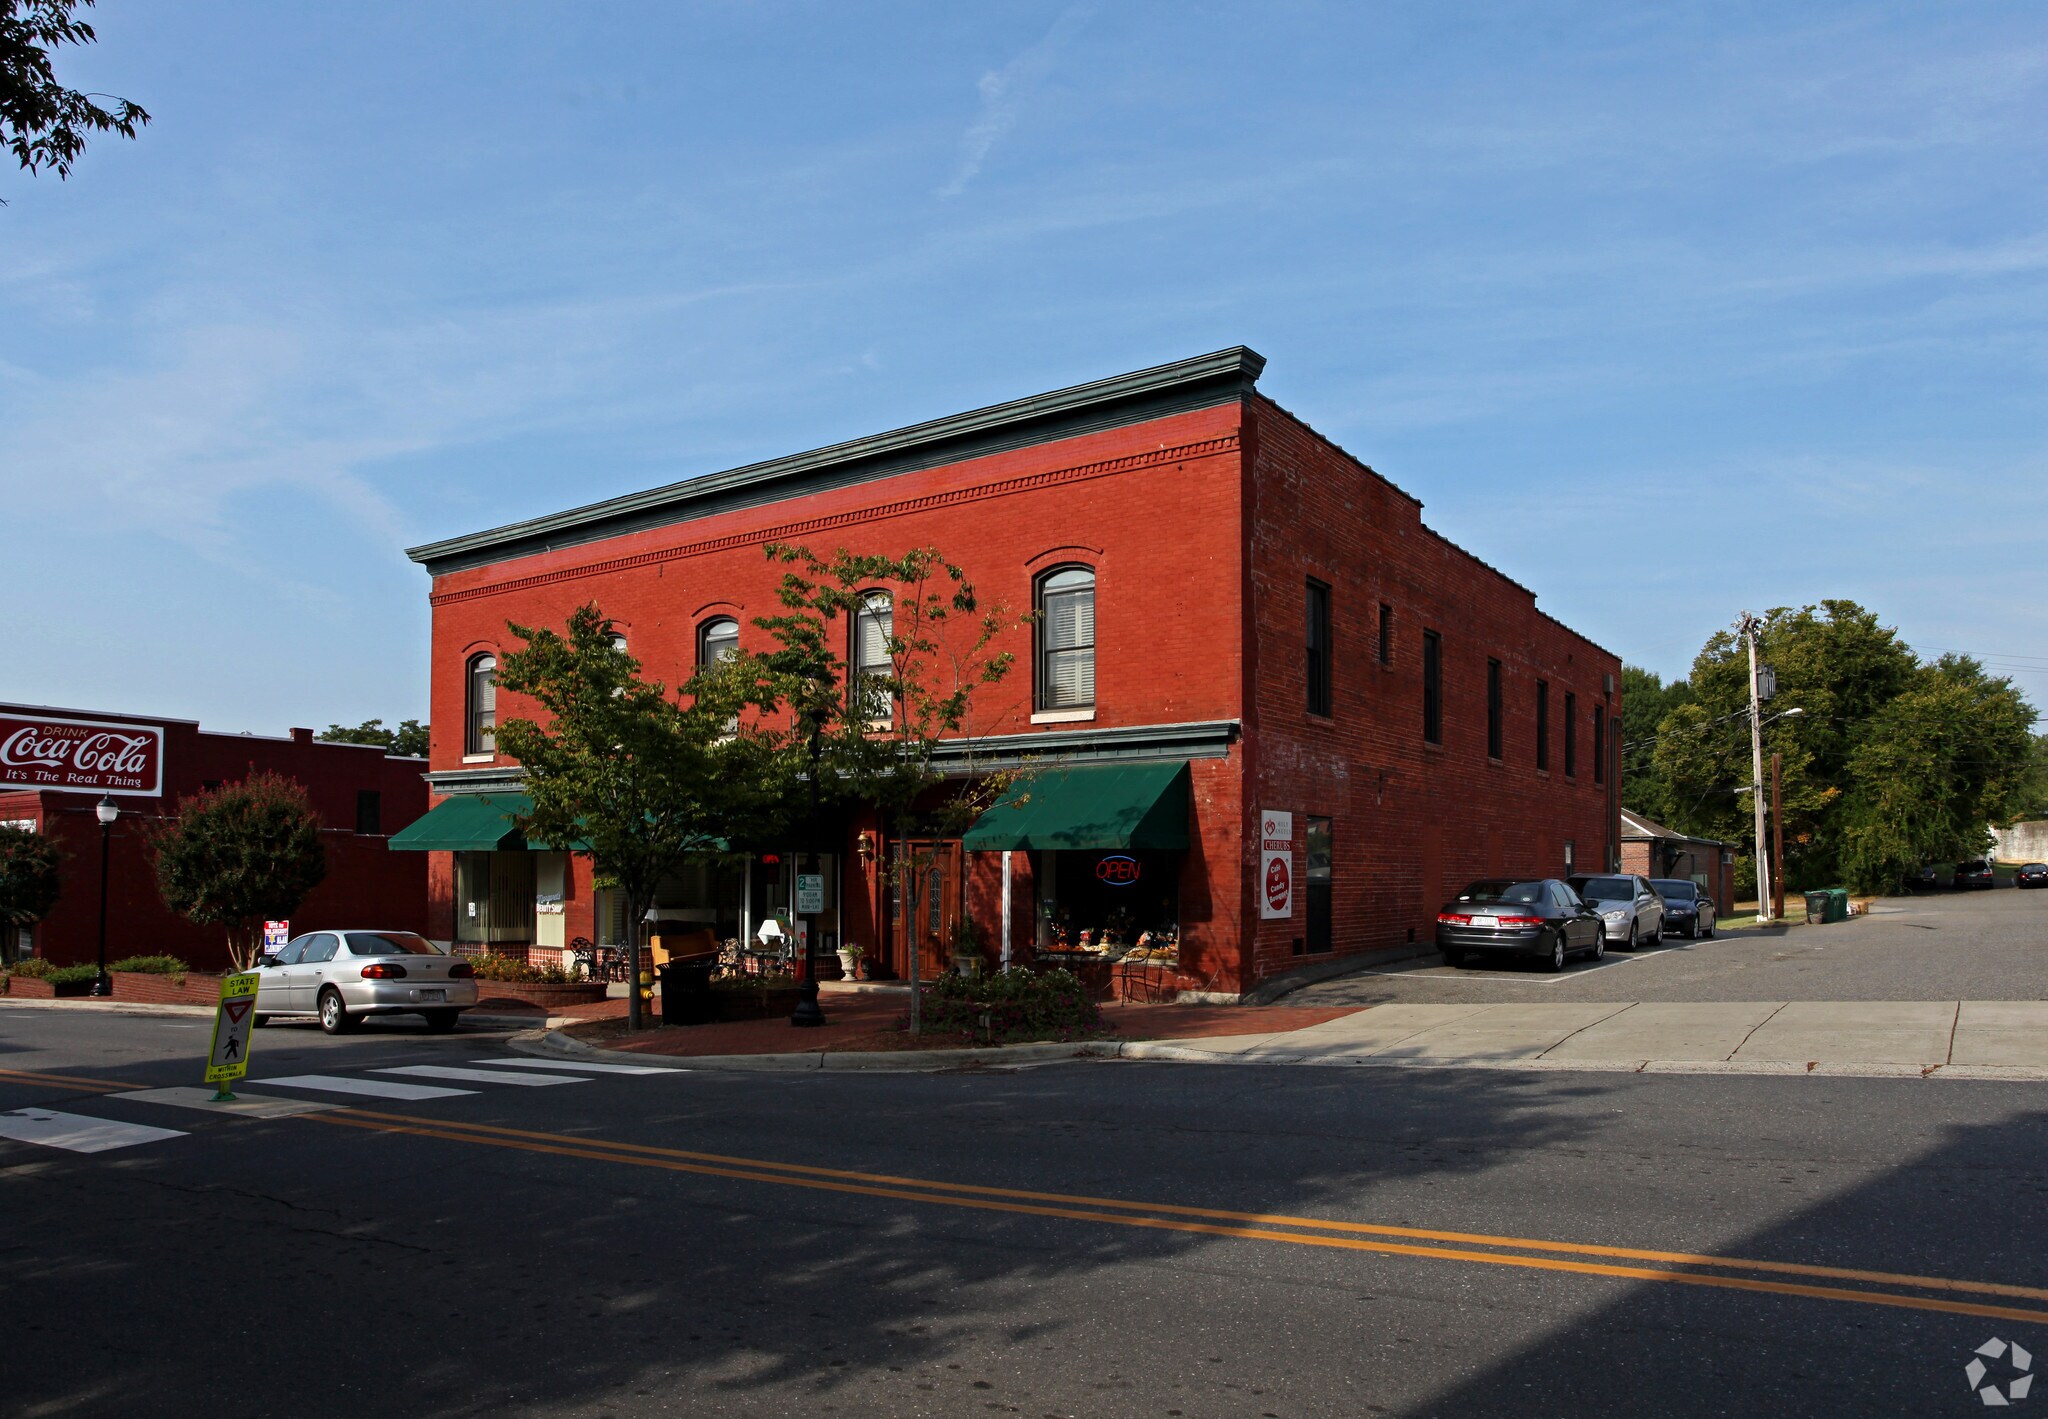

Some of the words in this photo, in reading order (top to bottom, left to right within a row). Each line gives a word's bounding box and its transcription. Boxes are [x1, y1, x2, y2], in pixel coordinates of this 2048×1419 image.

[43, 726, 89, 738] DRINK
[0, 727, 152, 773] Coca-Cola
[6, 769, 28, 781] It's
[34, 770, 60, 782] The
[67, 773, 98, 785] Real
[106, 775, 142, 788] Thing
[1265, 840, 1291, 851] CHERUBS
[1096, 861, 1142, 879] OPEN
[799, 878, 805, 888] 2
[230, 977, 255, 987] STATE
[232, 986, 250, 995] LAW
[209, 1071, 242, 1080] CROSSWALK
